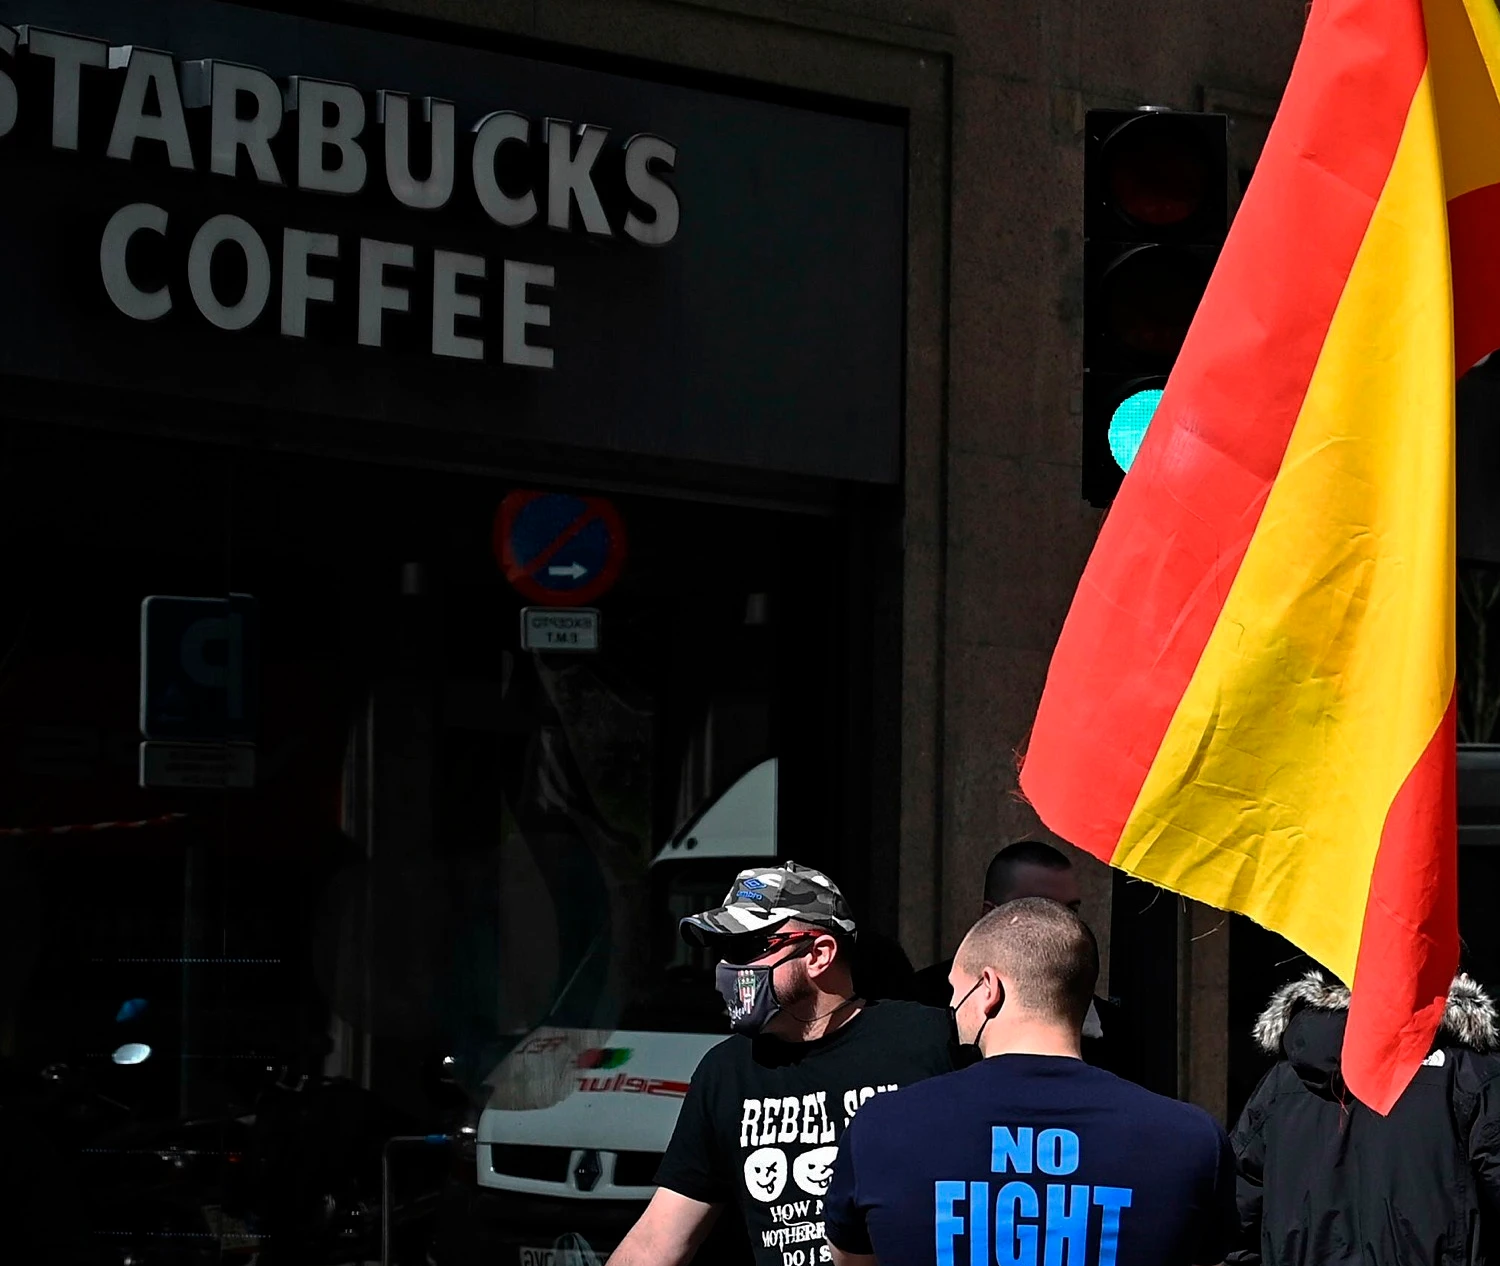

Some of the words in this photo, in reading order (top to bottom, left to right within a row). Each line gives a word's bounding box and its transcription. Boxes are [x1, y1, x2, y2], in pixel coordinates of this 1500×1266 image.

[100, 202, 556, 369] COFFEE
[740, 1091, 836, 1148] REBEL
[990, 1125, 1080, 1176] NO
[769, 1200, 811, 1223] HOW
